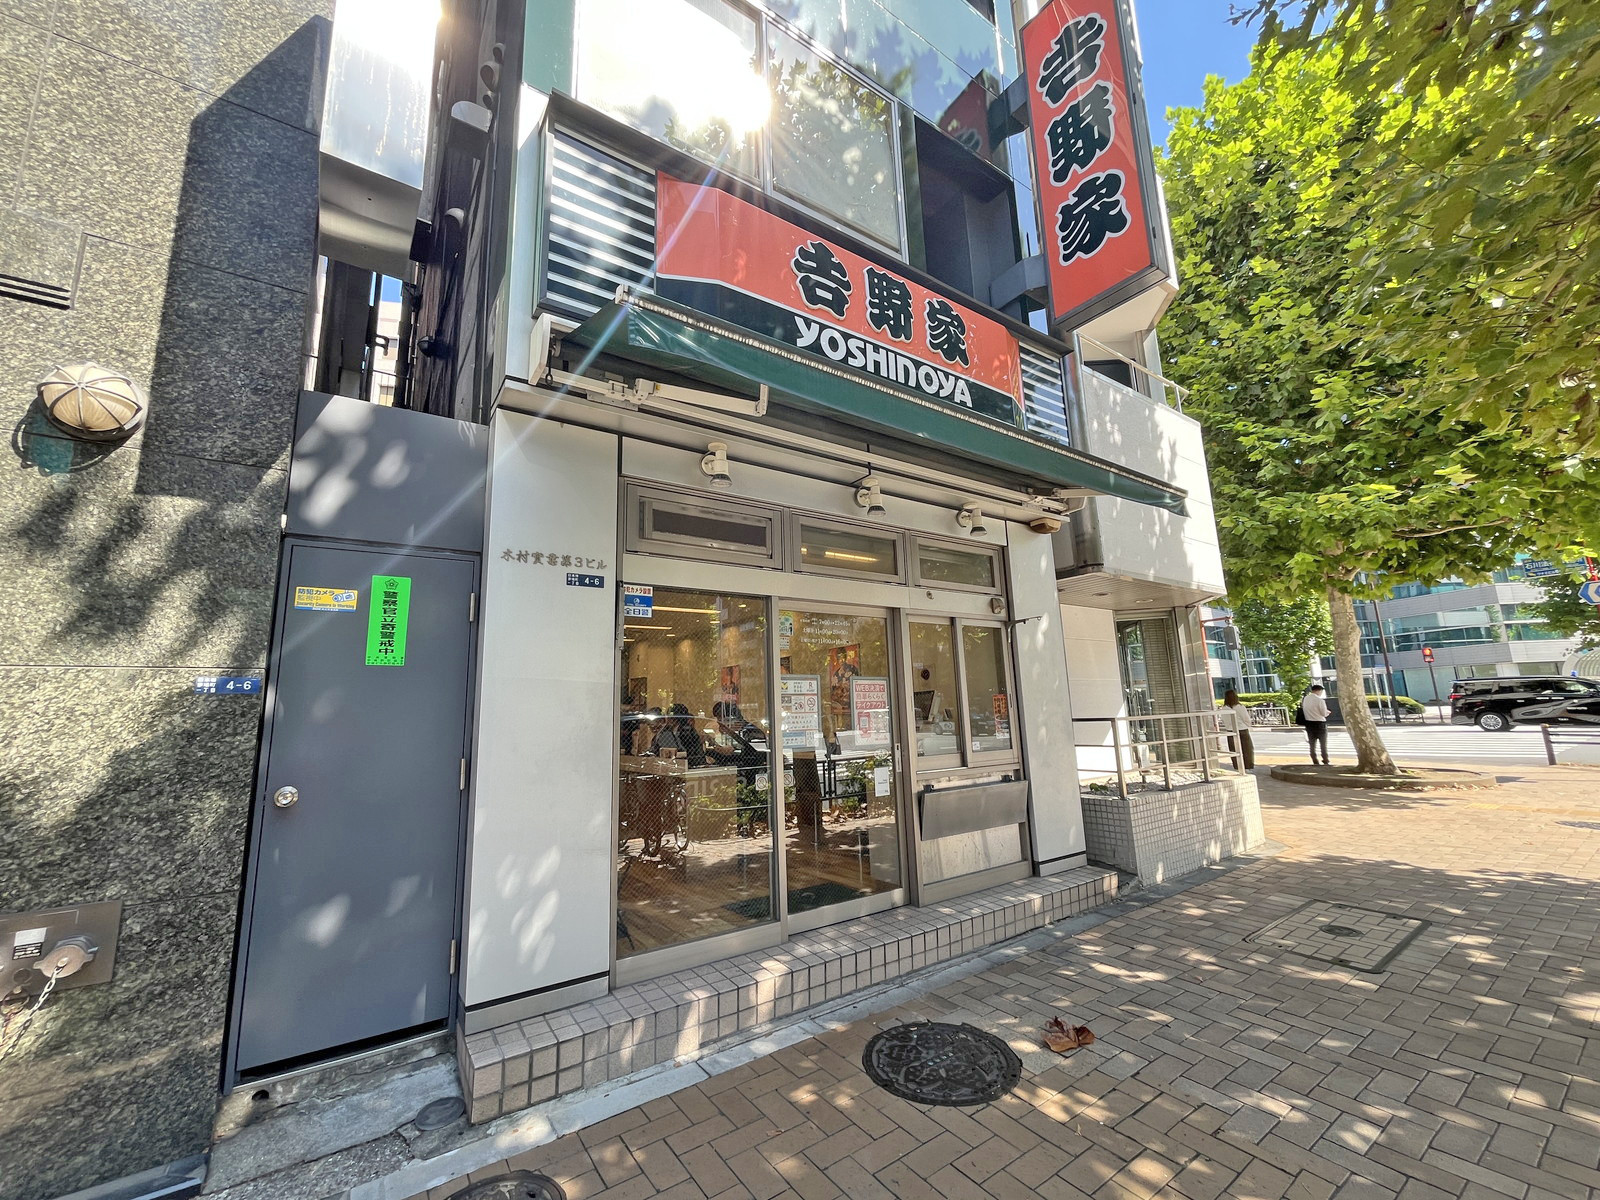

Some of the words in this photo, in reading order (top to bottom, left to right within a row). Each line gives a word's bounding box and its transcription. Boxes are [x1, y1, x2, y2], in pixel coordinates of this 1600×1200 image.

[1037, 12, 1131, 266] 吉野家
[790, 239, 971, 369] 吉野家
[794, 316, 973, 408] YOSHINOYA
[584, 577, 600, 586] 4-6
[297, 588, 335, 596] 防犯カメラ
[226, 680, 252, 690] 4-6
[856, 701, 886, 709] テイクアウト
